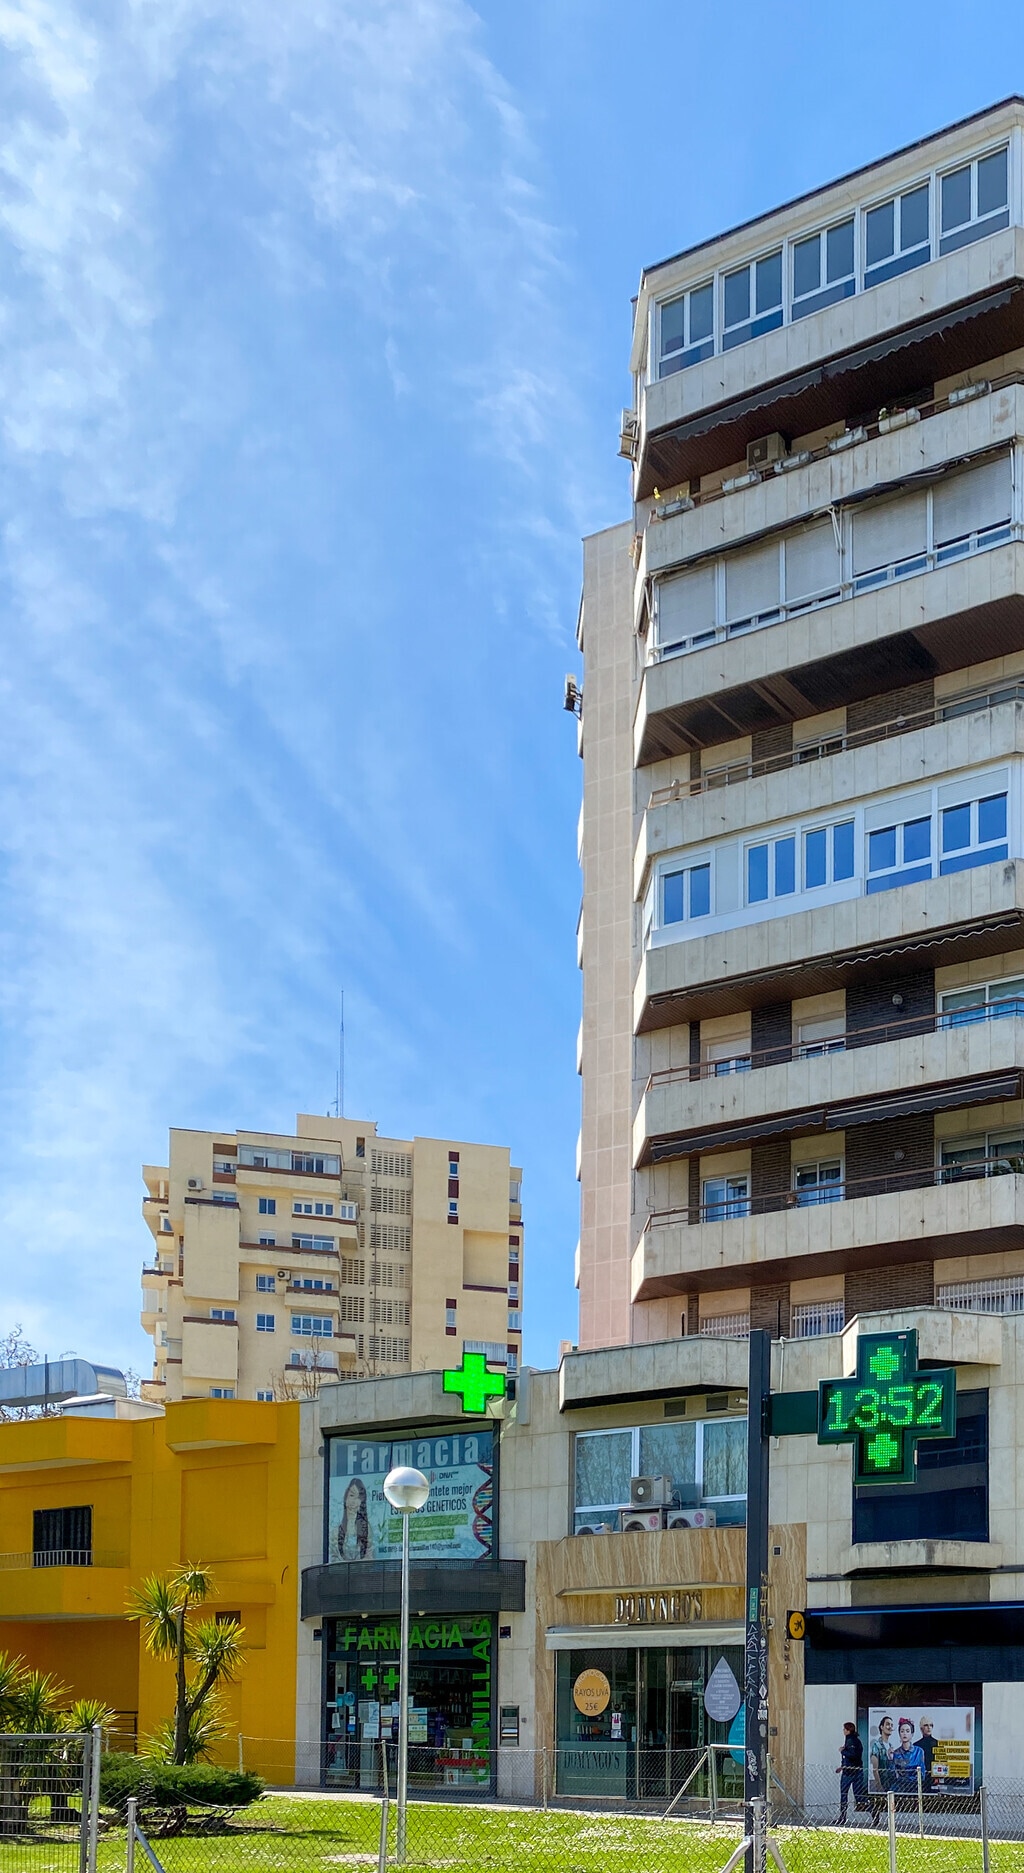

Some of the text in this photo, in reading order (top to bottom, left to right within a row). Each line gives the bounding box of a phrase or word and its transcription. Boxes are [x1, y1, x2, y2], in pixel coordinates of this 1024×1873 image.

[829, 1384, 942, 1430] 13:52
[347, 1434, 479, 1475] Farmacia
[451, 1483, 473, 1498] mejor
[427, 1498, 467, 1513] GENETICOS
[614, 1591, 703, 1623] DOMYNGO'S
[344, 1624, 464, 1651] FARMACIA
[472, 1617, 492, 1783] CANILLAS
[575, 1688, 609, 1697] RAYOS UVA
[585, 1702, 598, 1710] 25€
